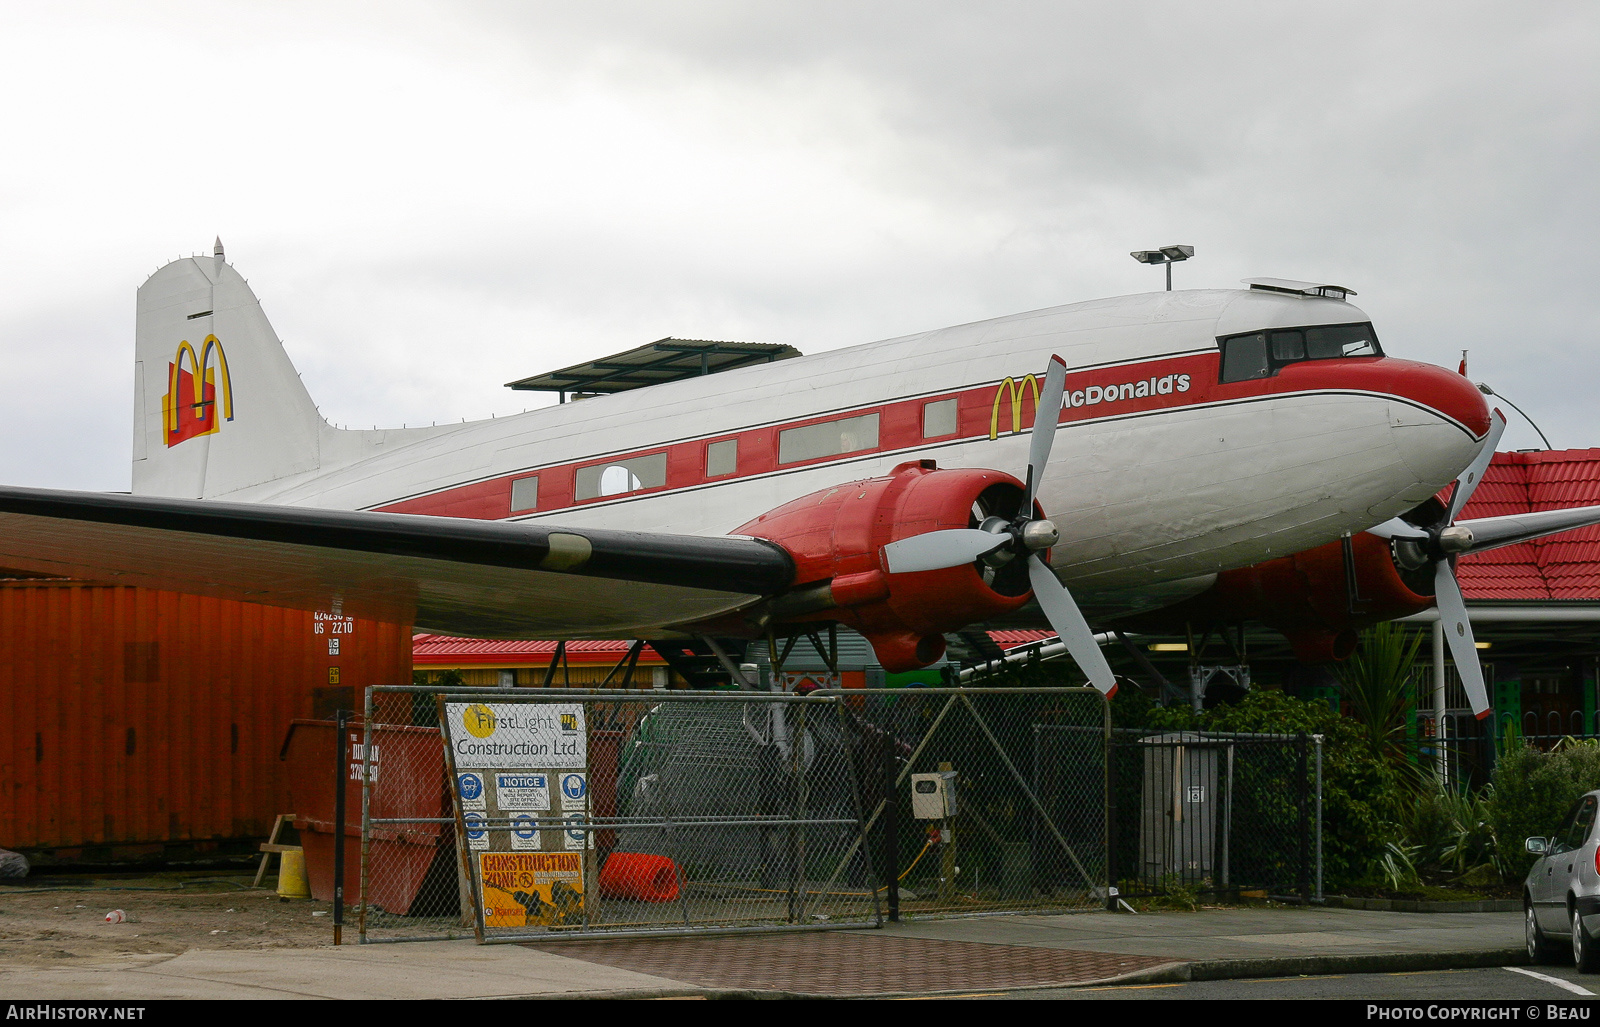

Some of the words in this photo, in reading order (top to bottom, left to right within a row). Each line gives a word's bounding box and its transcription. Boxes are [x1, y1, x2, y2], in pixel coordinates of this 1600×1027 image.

[314, 622, 324, 634] US
[331, 621, 353, 634] 2210
[478, 713, 554, 734] FirstLight
[457, 739, 548, 756] Construction
[554, 739, 580, 756] Ltd.
[503, 777, 541, 787] NOTICE
[483, 855, 579, 871] CONSTRUCTION
[484, 871, 518, 888] ZONE
